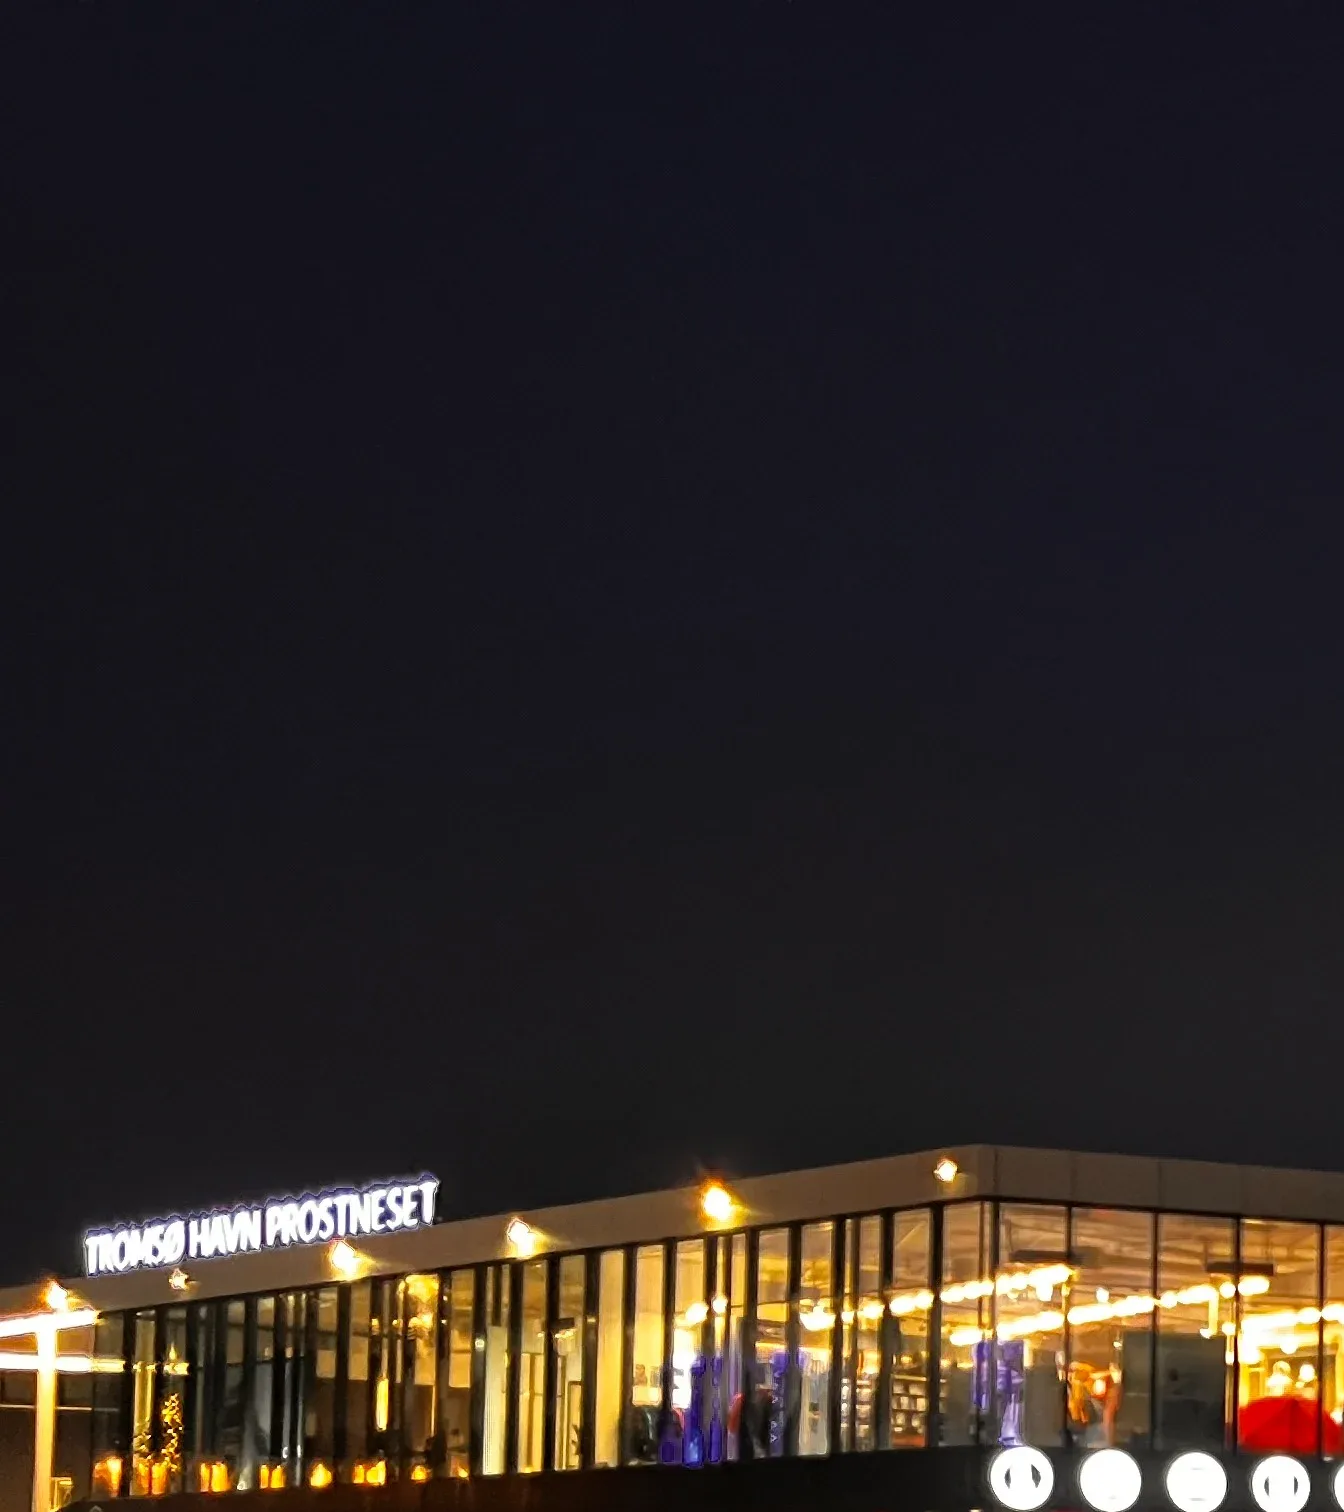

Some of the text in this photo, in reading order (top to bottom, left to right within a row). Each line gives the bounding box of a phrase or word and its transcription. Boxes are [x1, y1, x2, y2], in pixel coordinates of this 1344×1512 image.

[85, 1180, 438, 1274] TROMSØ HAVN PROSTNESET
